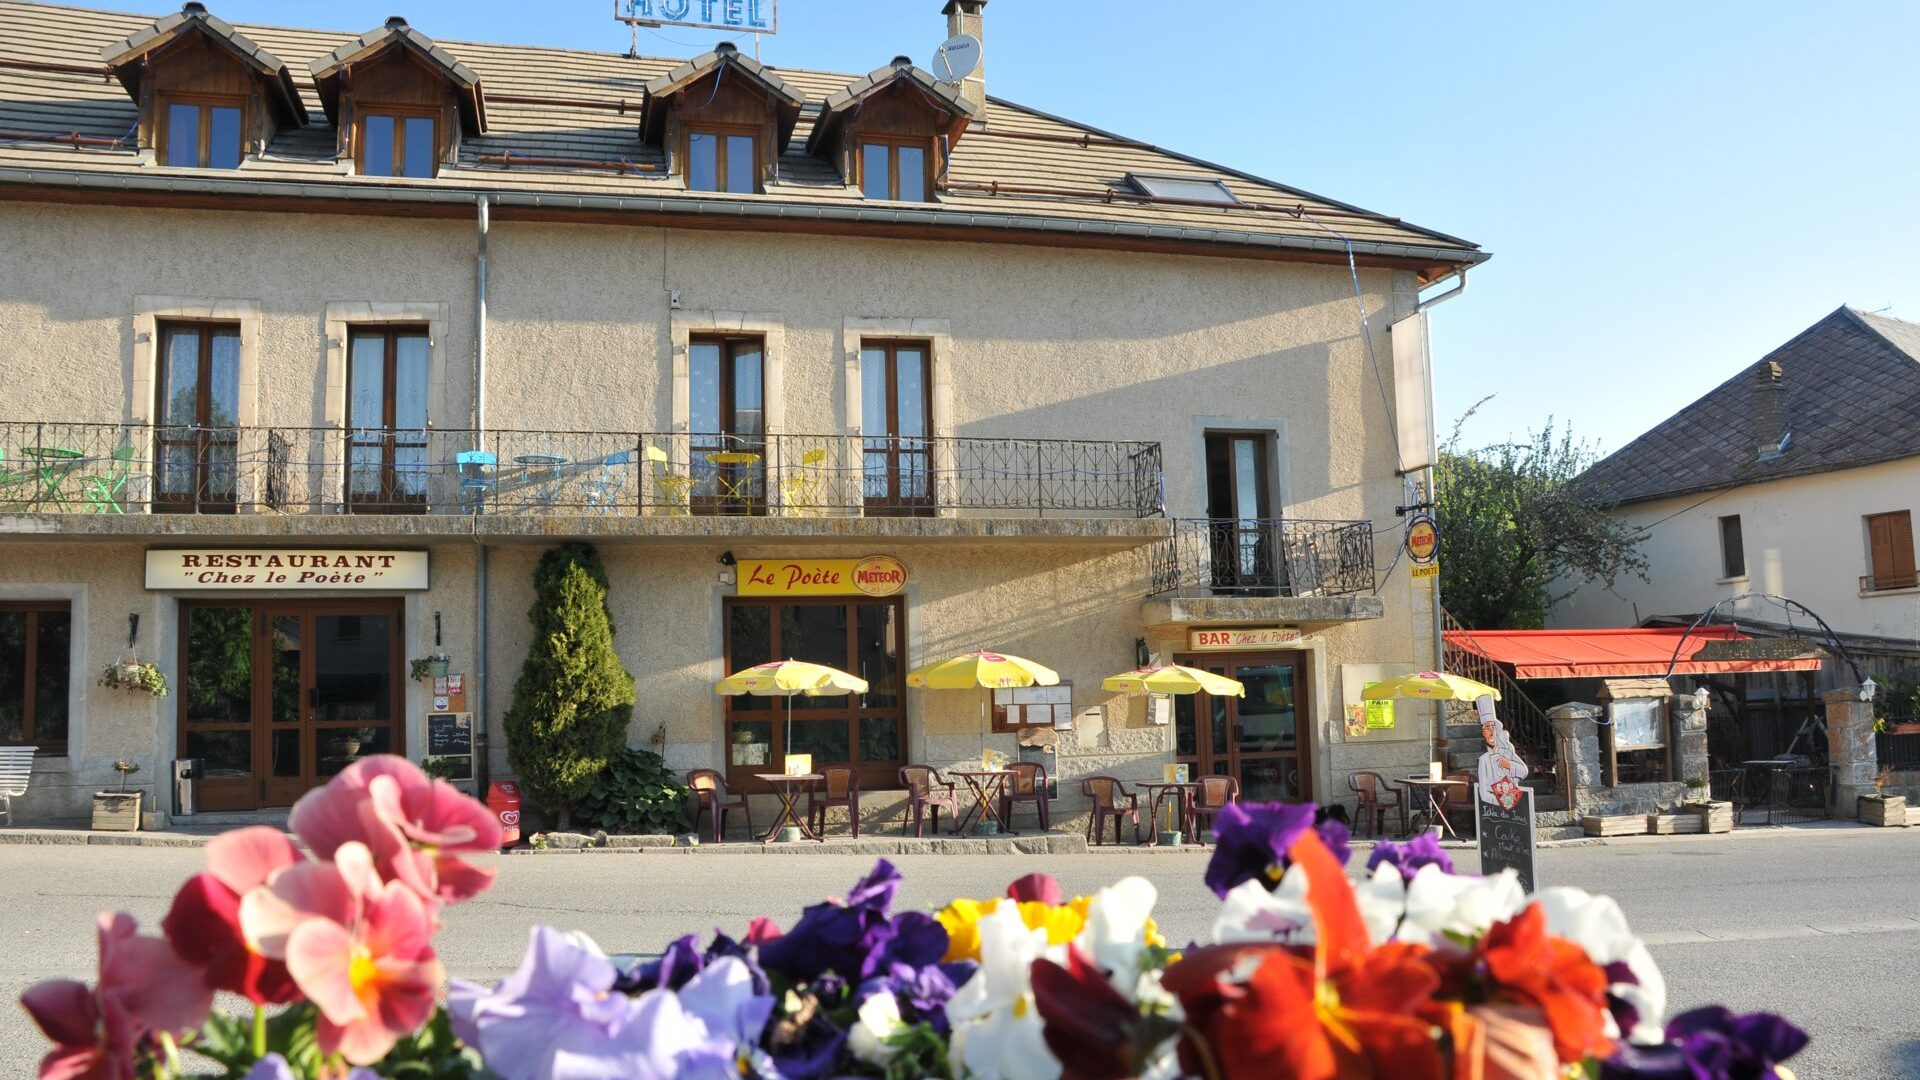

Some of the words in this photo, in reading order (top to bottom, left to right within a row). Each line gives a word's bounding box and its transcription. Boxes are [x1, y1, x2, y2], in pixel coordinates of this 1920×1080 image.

[1411, 533, 1434, 547] METEOR
[182, 554, 396, 568] RESTAURANT
[265, 571, 287, 583] le
[748, 564, 775, 586] Le
[782, 564, 840, 590] Poète
[857, 570, 901, 584] METEOR
[1199, 632, 1230, 645] BAR
[1261, 632, 1268, 643] le
[1729, 649, 1751, 659] CHEZ
[1757, 649, 1766, 658] LE
